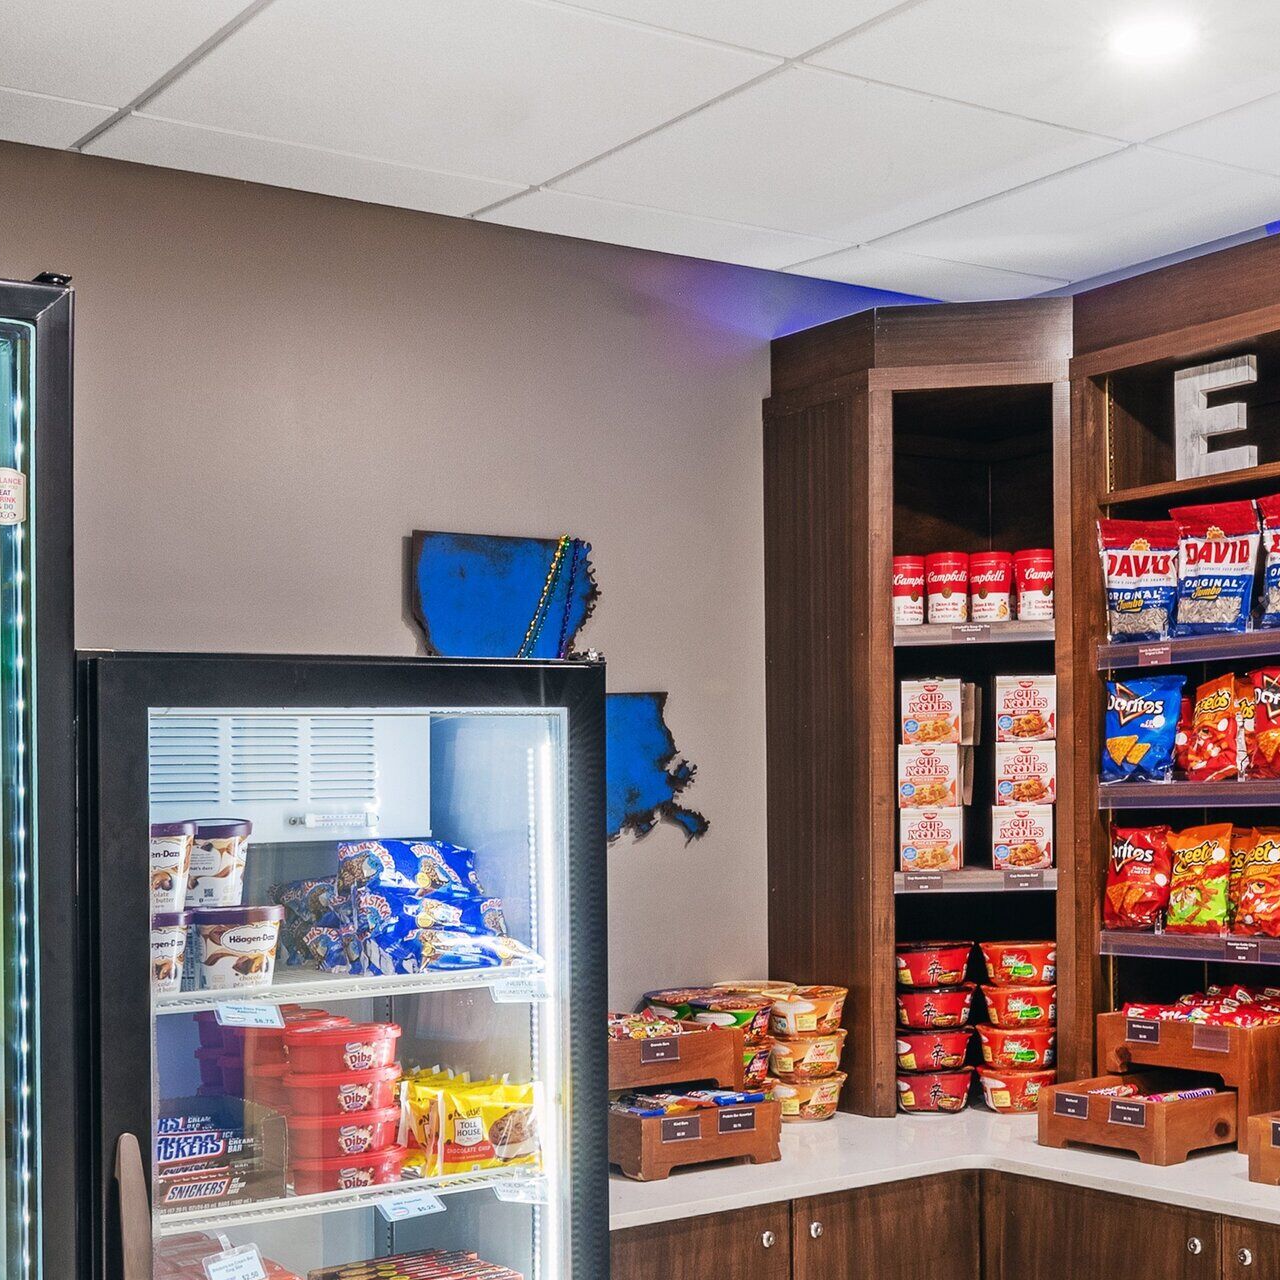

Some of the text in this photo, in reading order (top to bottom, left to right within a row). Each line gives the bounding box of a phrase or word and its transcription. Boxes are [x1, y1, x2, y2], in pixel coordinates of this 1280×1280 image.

[1185, 540, 1250, 565] DAVID
[1185, 579, 1238, 588] ORIGINAL
[919, 692, 943, 703] CUP
[1013, 689, 1039, 701] CUP
[908, 701, 953, 713] NOODLES
[1003, 698, 1049, 710] NOODLES
[915, 756, 940, 768] CUP
[1013, 754, 1039, 765] CUP
[905, 765, 949, 777] NOODLES
[1003, 762, 1048, 774] NOODLES
[917, 820, 943, 831] CUP
[1010, 818, 1035, 829] CUP
[908, 829, 951, 841] NOODLES
[999, 827, 1045, 839] NOODLES
[928, 960, 942, 983] 辛
[923, 1002, 937, 1025] 辛
[349, 1050, 372, 1067] Dibs
[932, 1043, 945, 1067] 辛
[343, 1093, 368, 1108] Dibs
[930, 1083, 943, 1107] 辛
[459, 1120, 478, 1130] TOLL
[457, 1128, 481, 1138] HOUSE
[344, 1134, 368, 1150] Dibs
[343, 1174, 368, 1189] Dibs
[168, 1181, 225, 1200] SNICKERS
